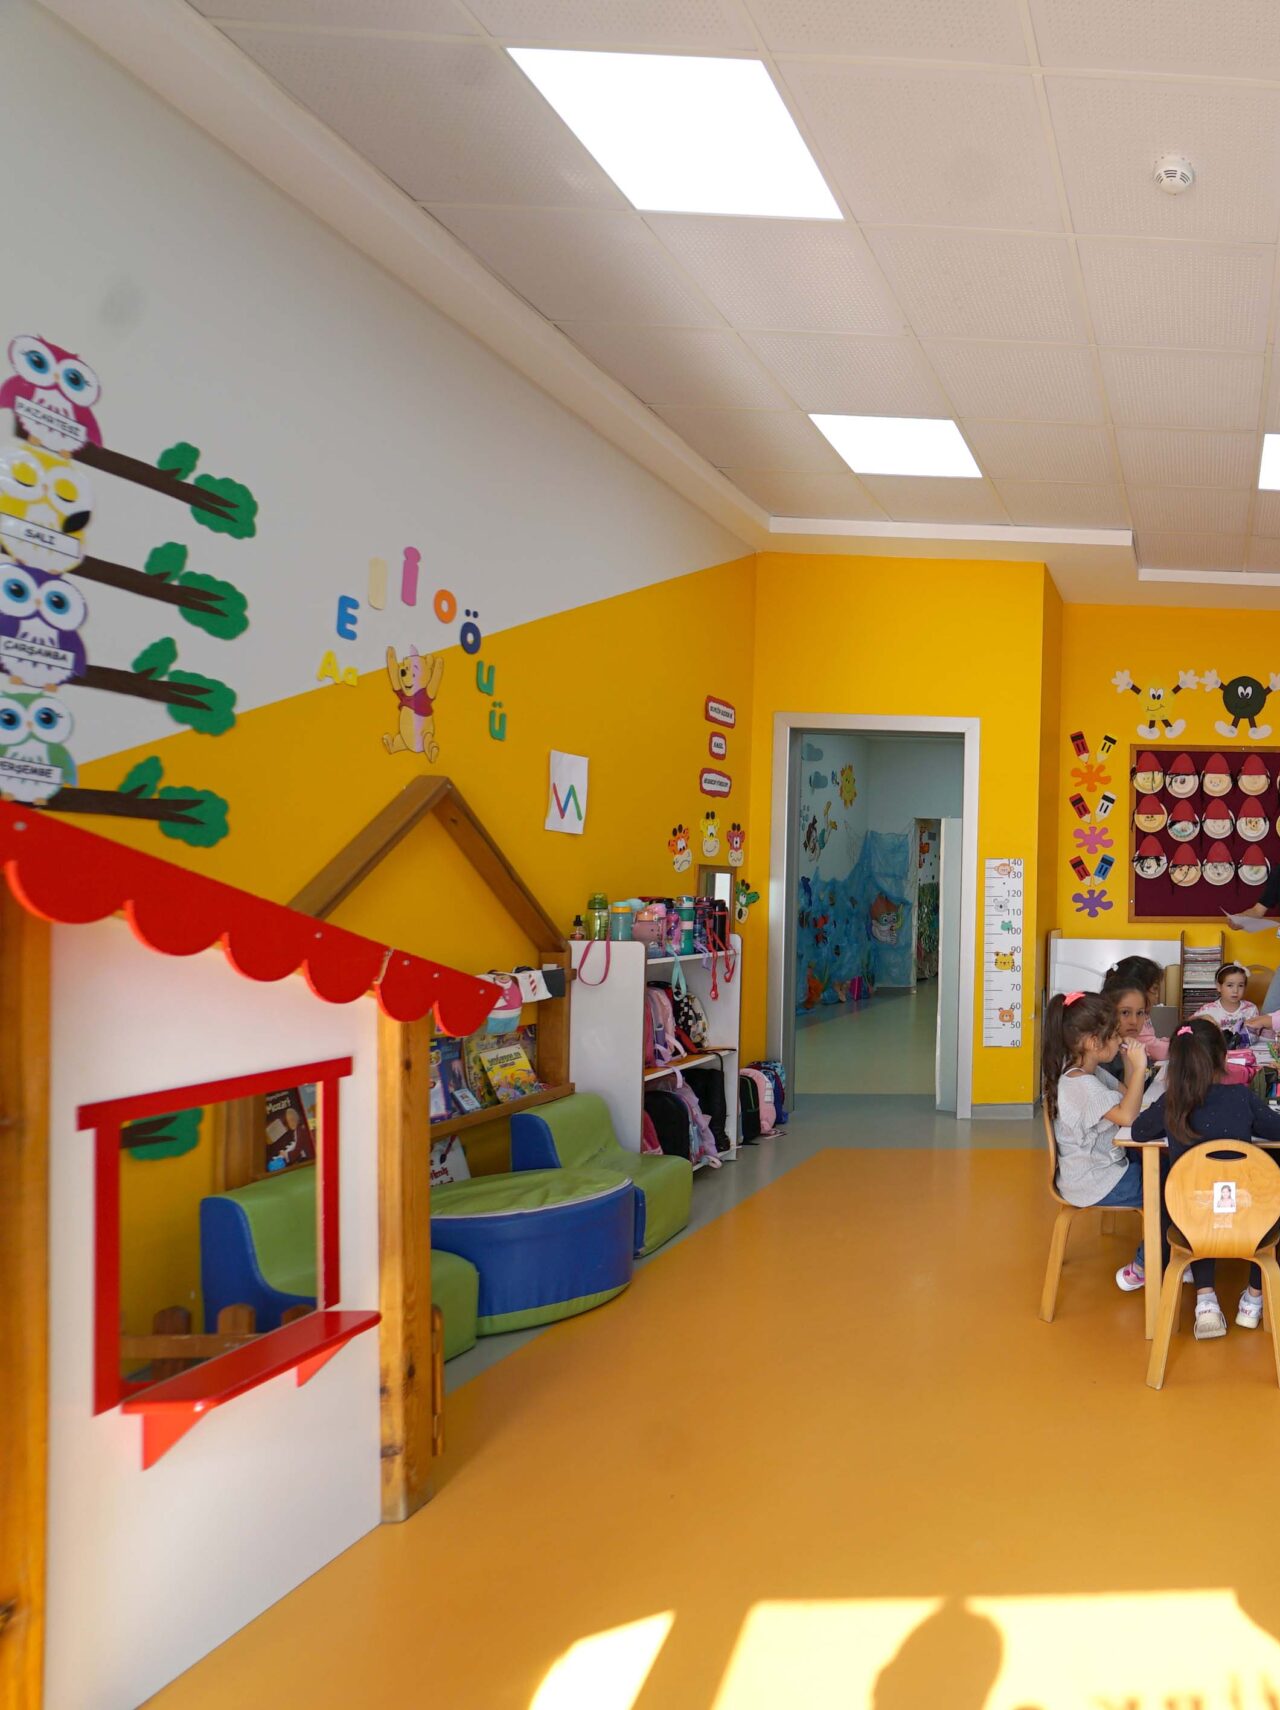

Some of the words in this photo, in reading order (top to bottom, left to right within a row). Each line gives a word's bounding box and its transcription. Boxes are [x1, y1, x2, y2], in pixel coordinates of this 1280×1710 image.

[24, 528, 56, 545] SALI
[336, 595, 360, 641] E
[4, 640, 67, 662] ÇARŞAMBA
[0, 759, 54, 778] ERŞEMBE
[1008, 871, 1022, 879] 130
[1007, 927, 1022, 935] 100
[1011, 983, 1021, 991] 70
[1010, 1002, 1021, 1010] 60
[1011, 1021, 1021, 1029] 50
